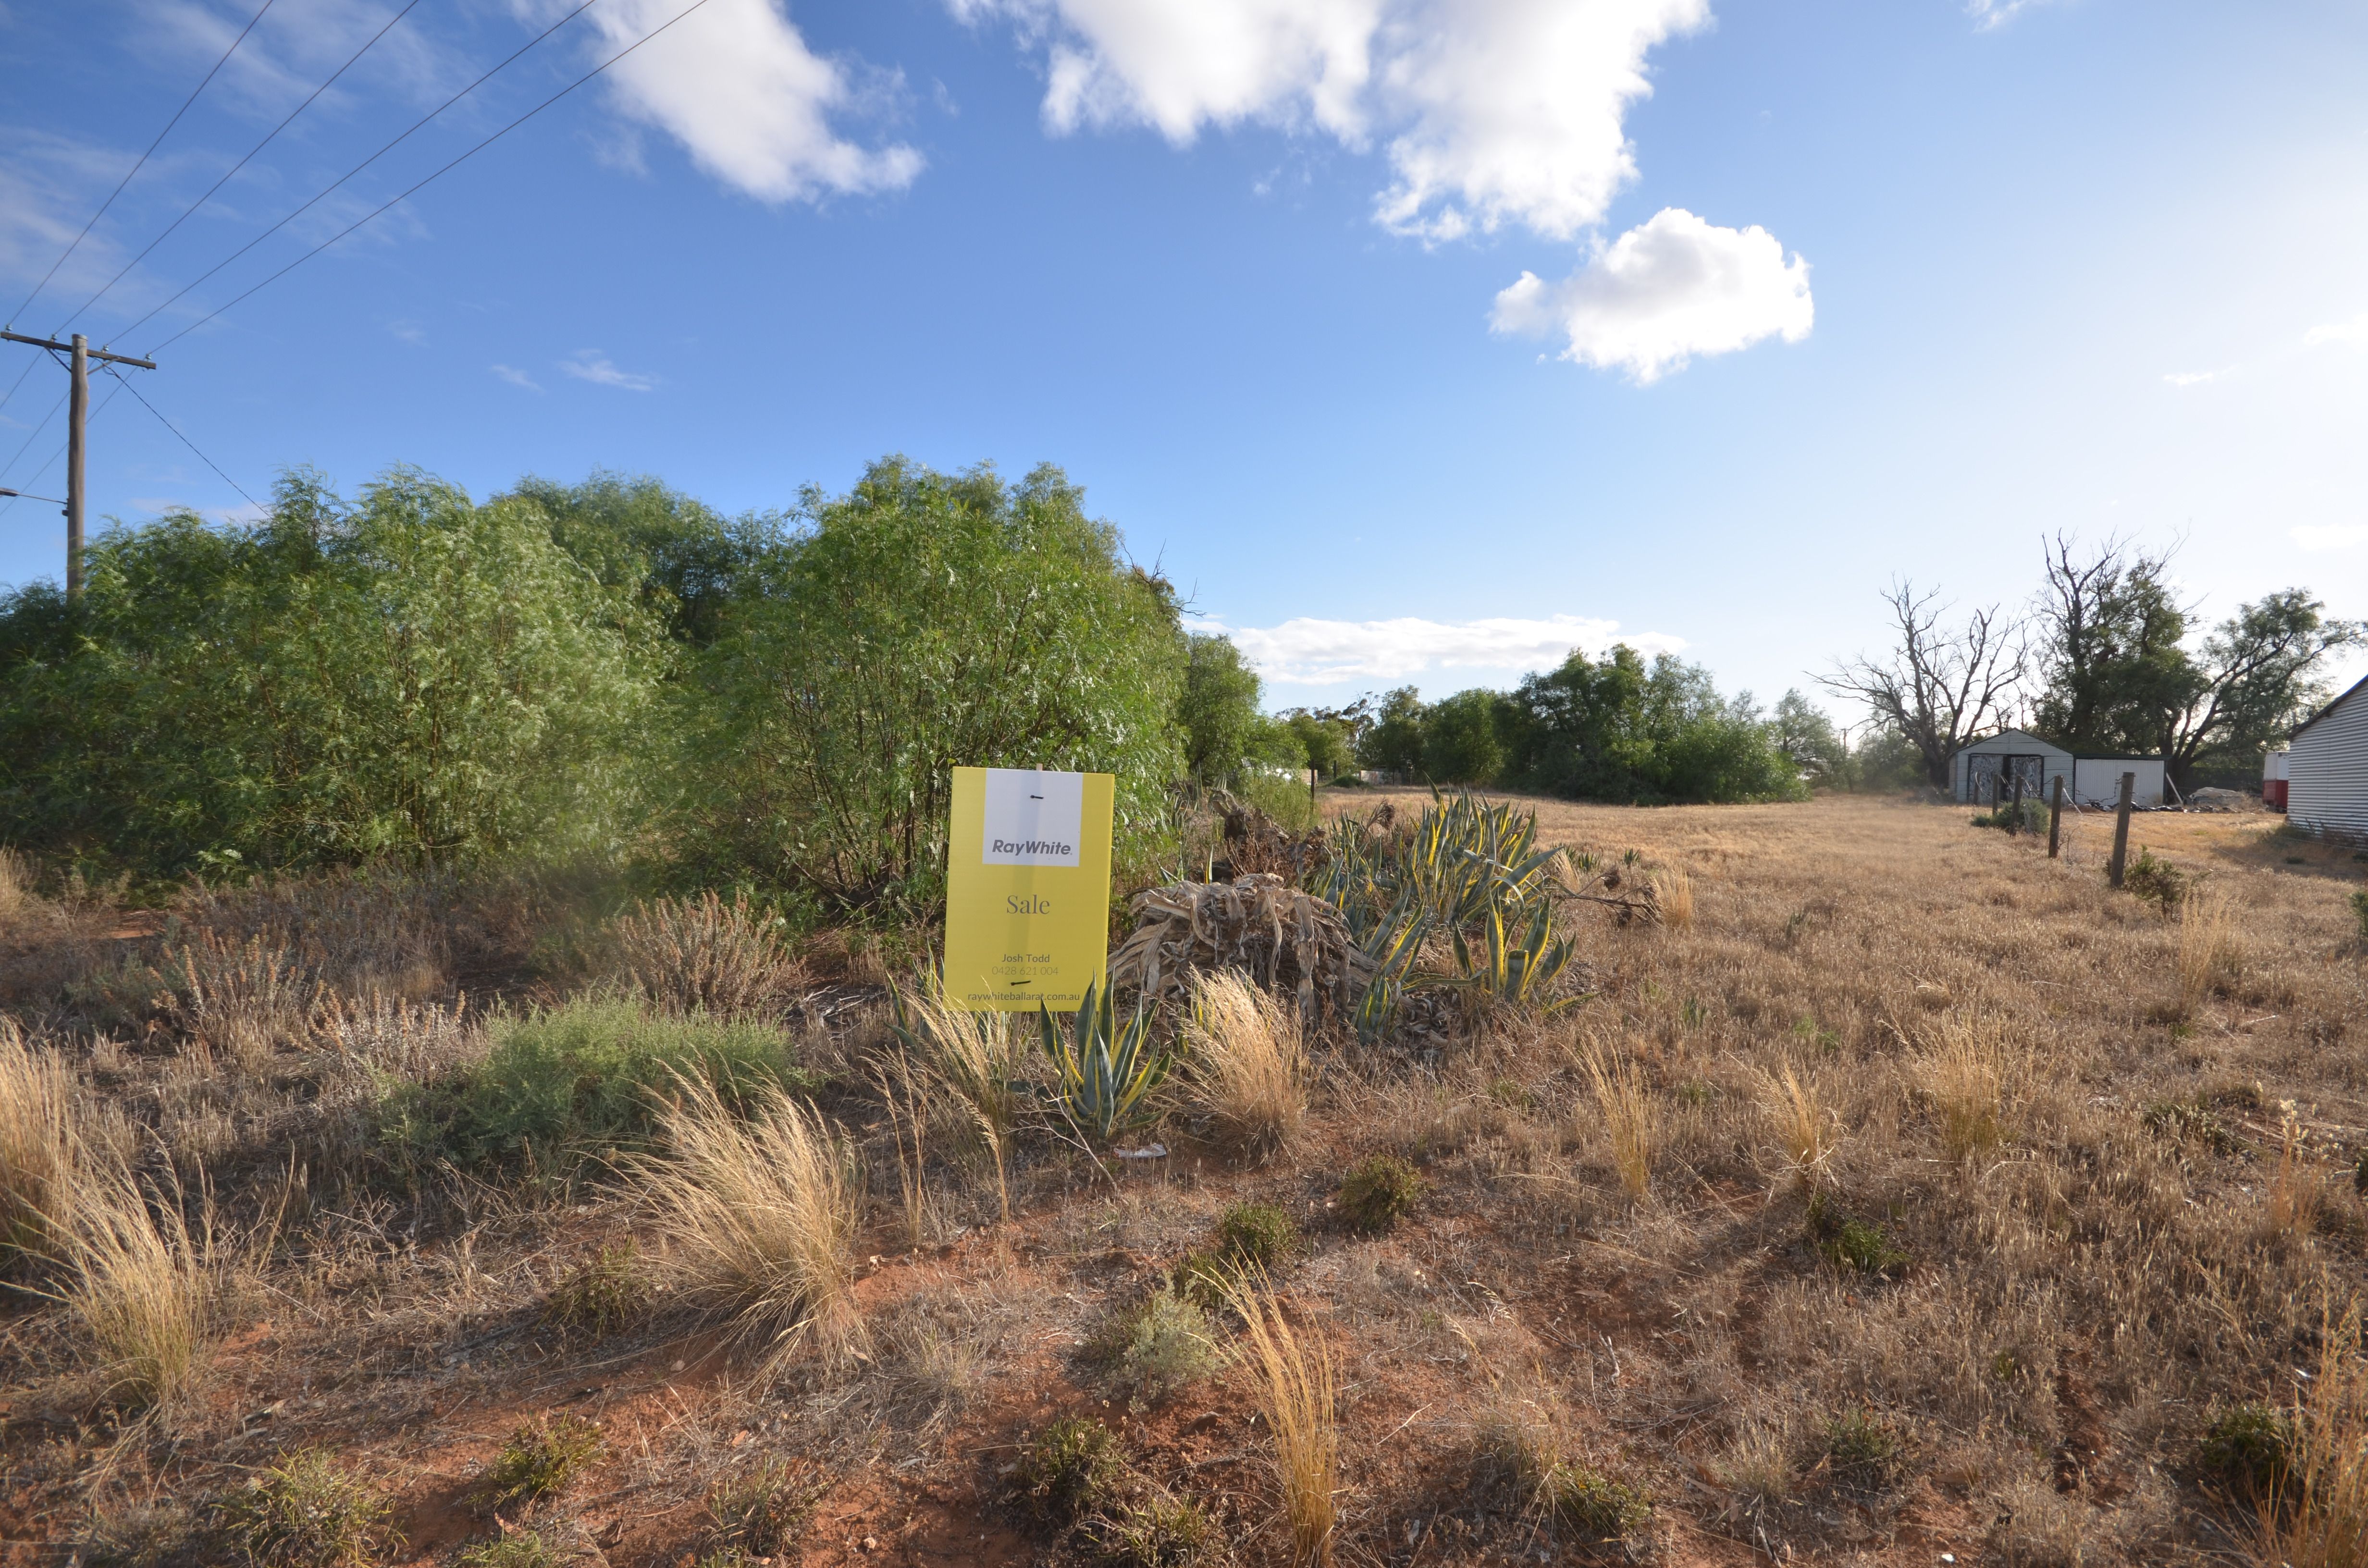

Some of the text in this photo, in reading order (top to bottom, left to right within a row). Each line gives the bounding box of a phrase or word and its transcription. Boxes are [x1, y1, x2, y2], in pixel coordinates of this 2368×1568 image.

[1007, 894, 1050, 915] Sale
[1001, 954, 1050, 963] Josh Todd
[992, 966, 1059, 975] 0428 621 004
